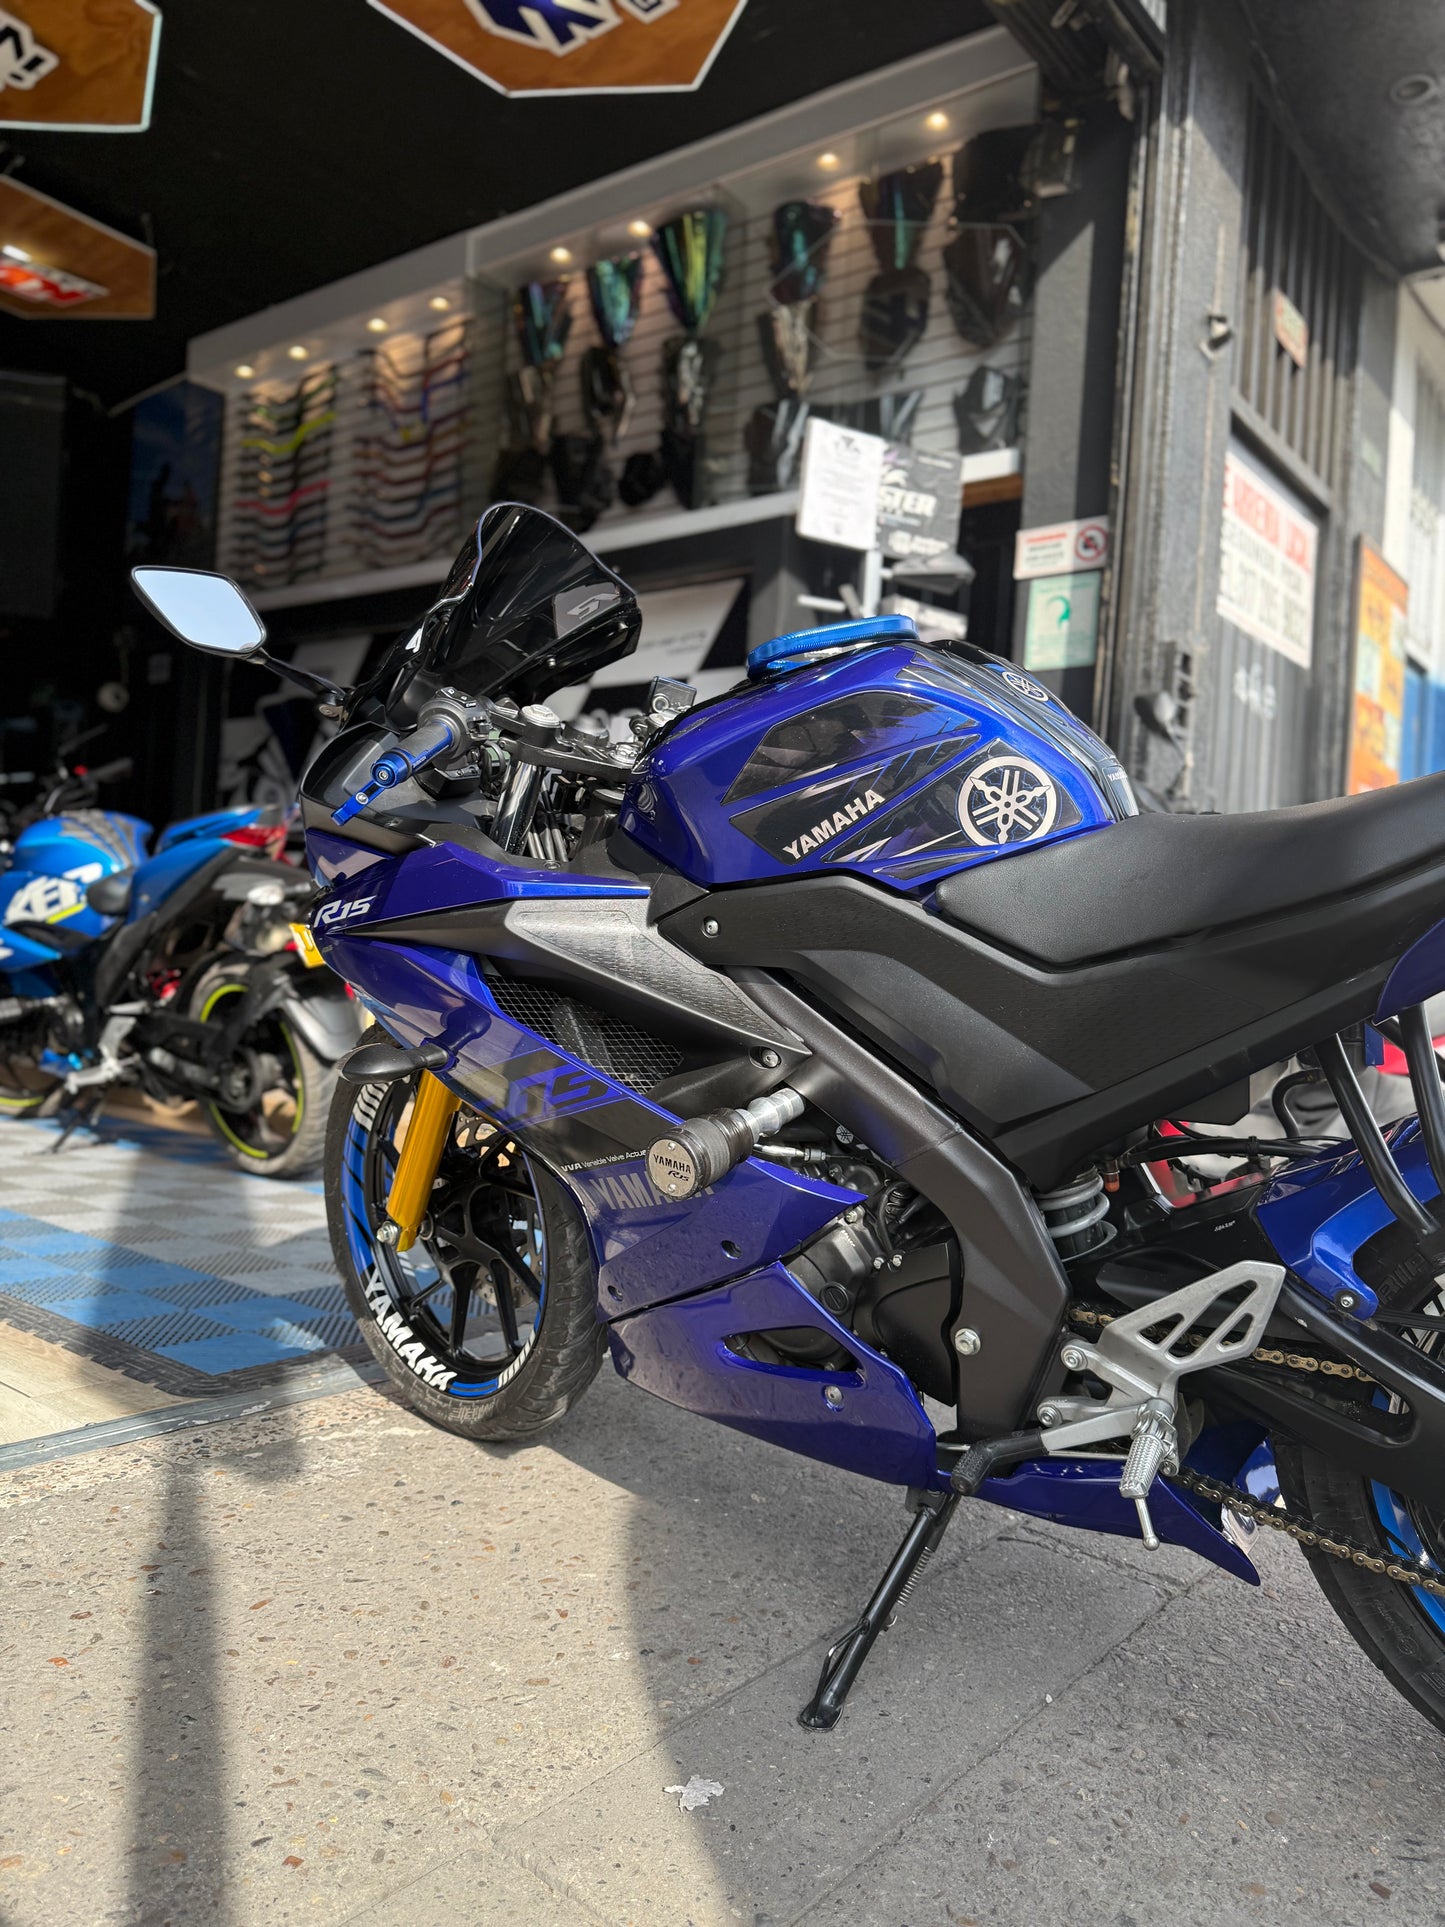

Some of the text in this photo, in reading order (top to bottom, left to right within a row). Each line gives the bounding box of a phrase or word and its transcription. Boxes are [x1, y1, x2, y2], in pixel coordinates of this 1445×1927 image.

[783, 789, 885, 860] YAMAHA
[313, 895, 377, 928] R15
[561, 1162, 583, 1172] VVA
[581, 1157, 607, 1168] Variable
[605, 1153, 625, 1163] Valve
[653, 1154, 691, 1174] YAMAHA
[668, 1170, 690, 1181] R15
[364, 1267, 458, 1391] YAMAHA
